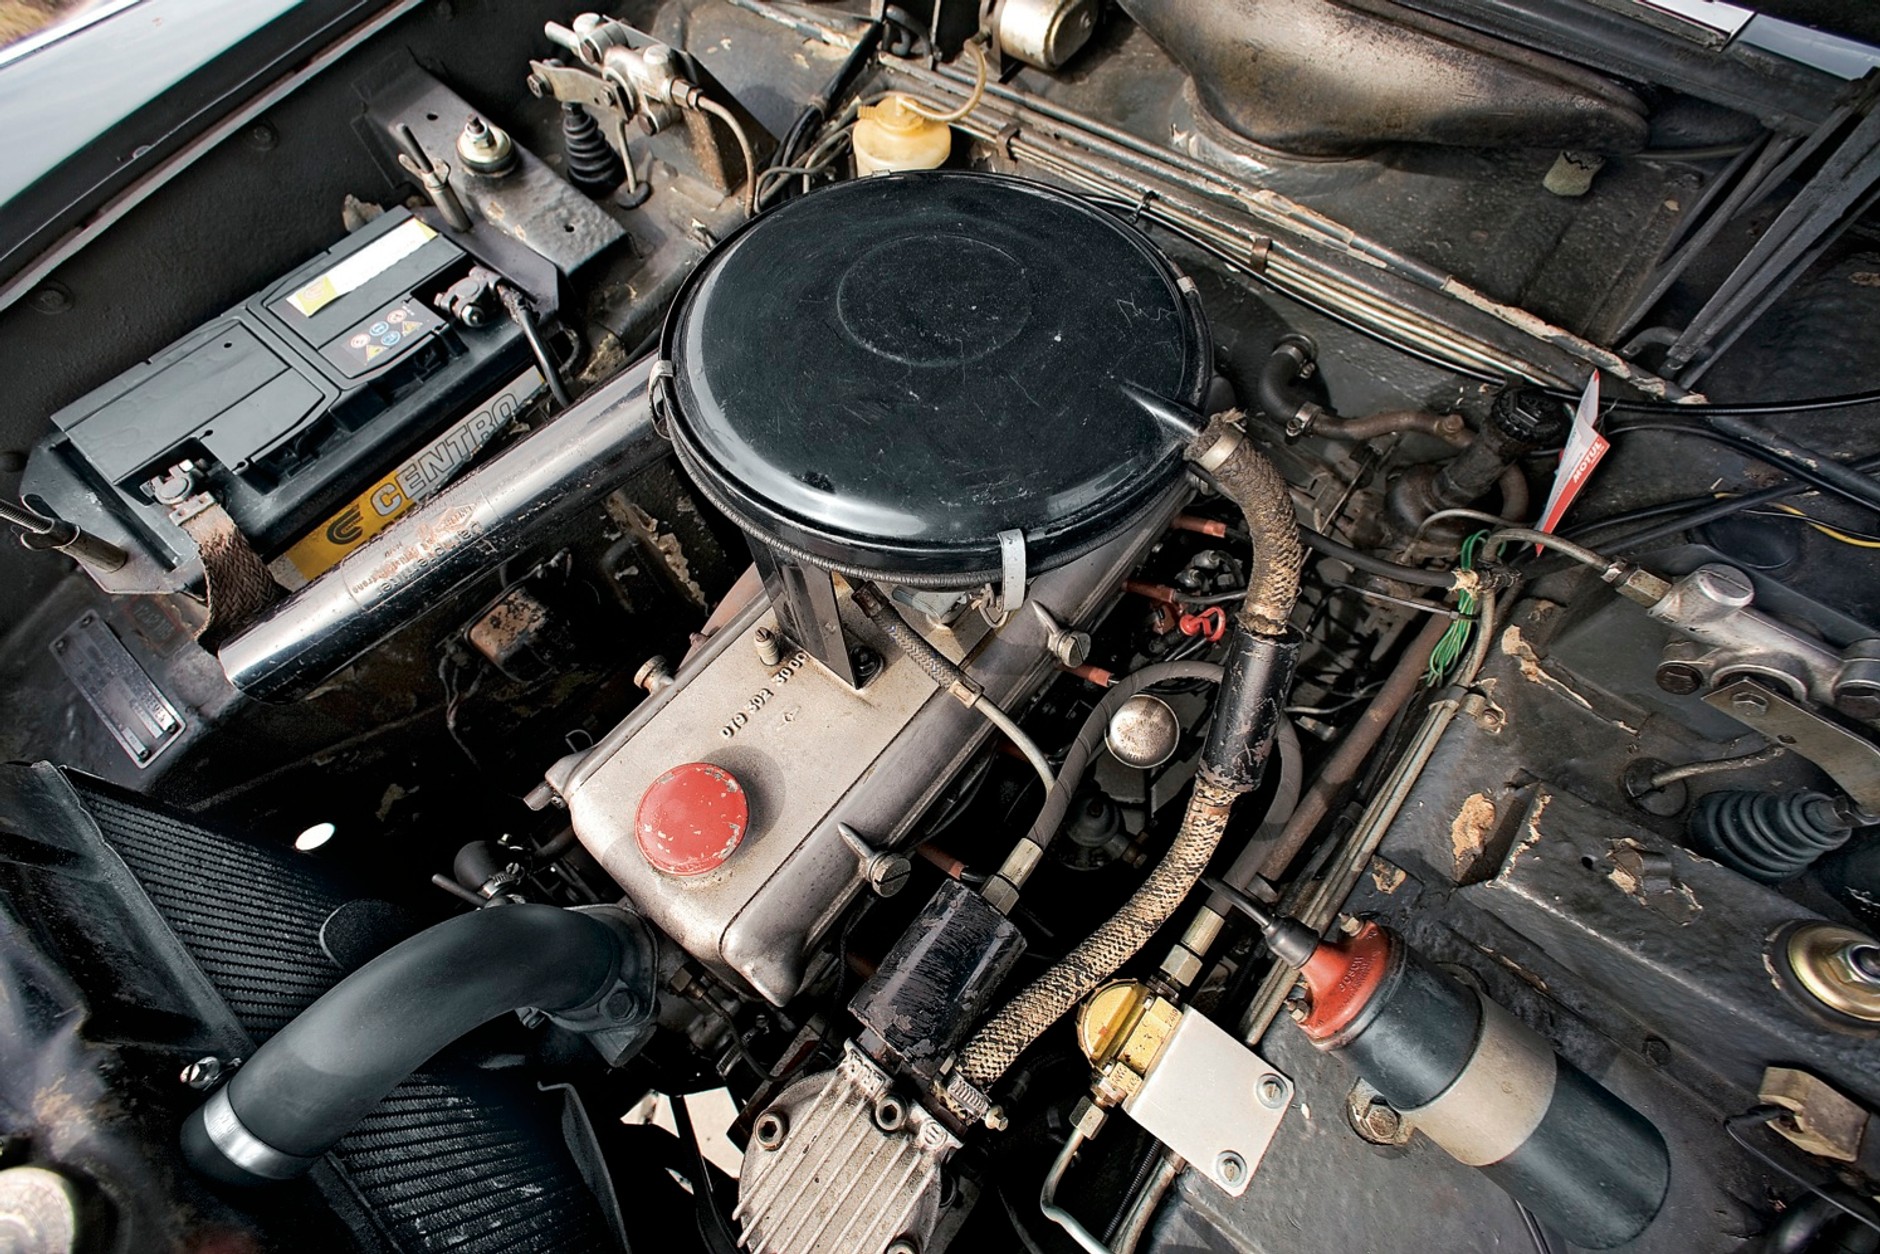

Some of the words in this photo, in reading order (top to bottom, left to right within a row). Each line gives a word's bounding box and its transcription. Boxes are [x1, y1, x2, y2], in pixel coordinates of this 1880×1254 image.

[369, 393, 519, 517] CENTRO
[1572, 440, 1604, 484] MOTUL
[720, 712, 748, 739] 079
[744, 687, 774, 715] 302
